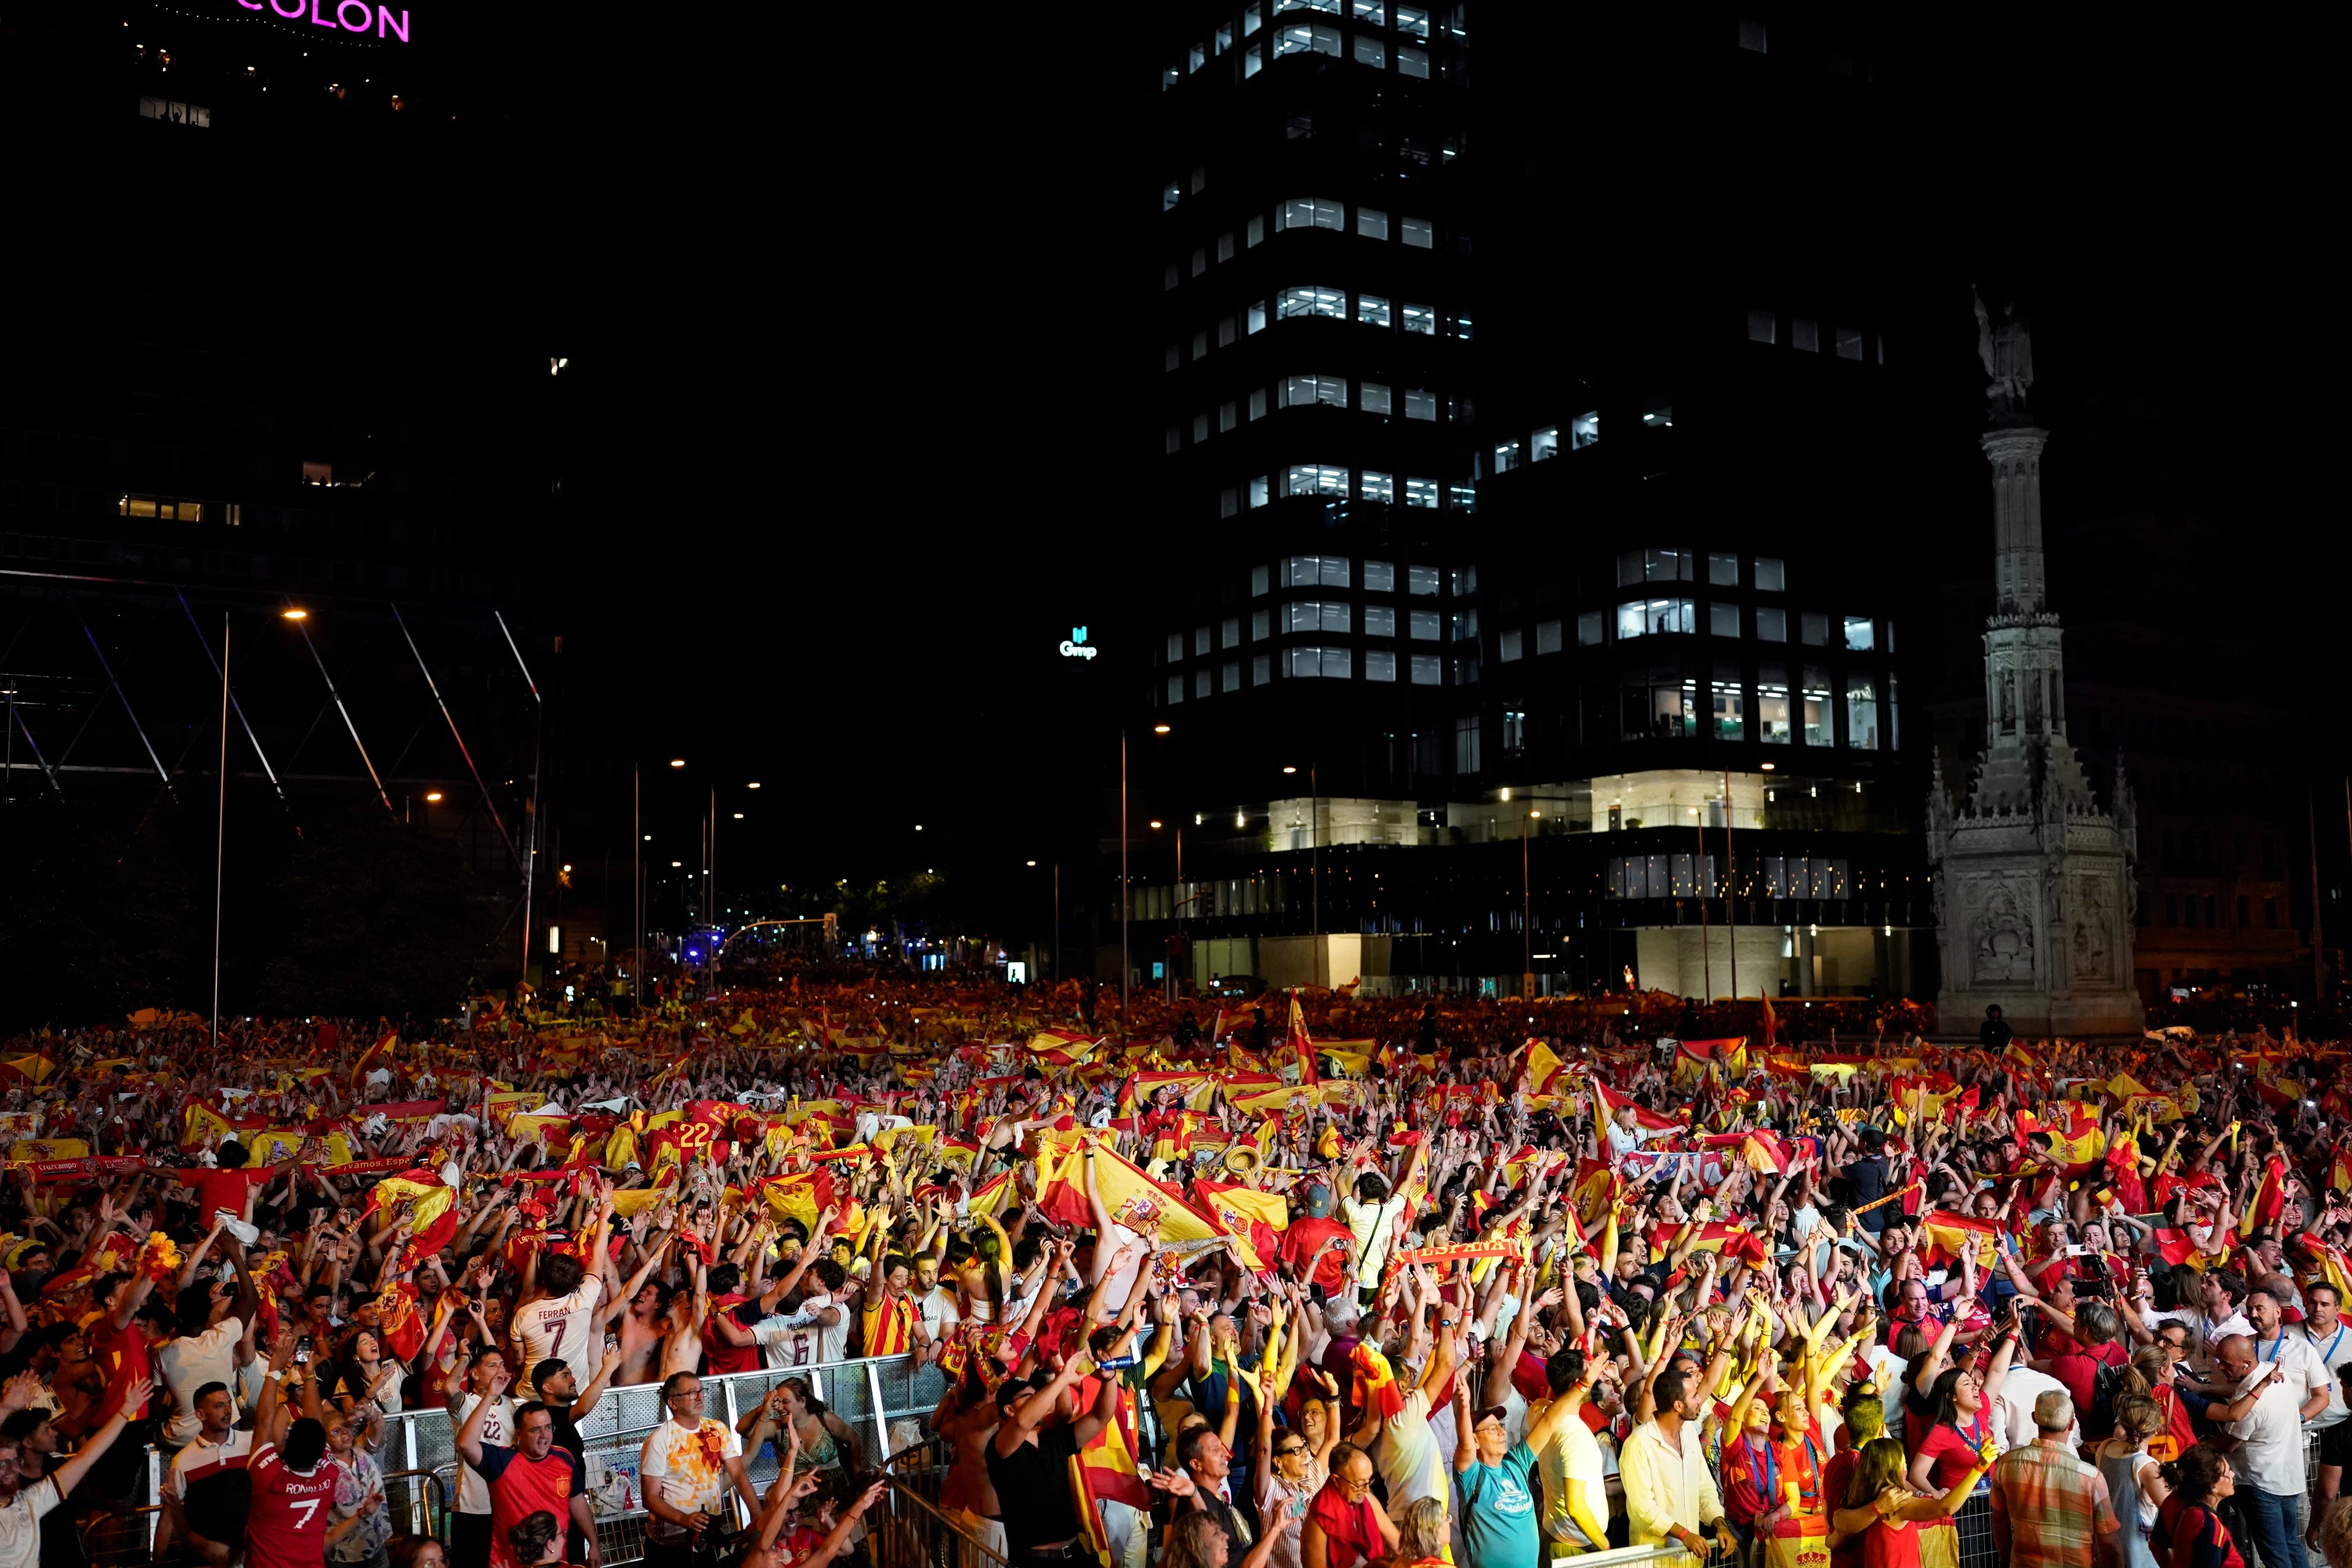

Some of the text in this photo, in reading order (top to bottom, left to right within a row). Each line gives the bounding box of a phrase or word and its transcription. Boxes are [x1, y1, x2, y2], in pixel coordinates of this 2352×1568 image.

[1059, 640, 1098, 661] Gmp
[680, 1123, 710, 1148] 22
[38, 1163, 78, 1171] Cruzcampo
[539, 1306, 571, 1320] FERRAN
[543, 1317, 568, 1358] 7
[793, 1333, 809, 1366] 6
[483, 1420, 501, 1441] 22
[285, 1478, 331, 1495] RONALDO
[289, 1497, 321, 1530] 7
